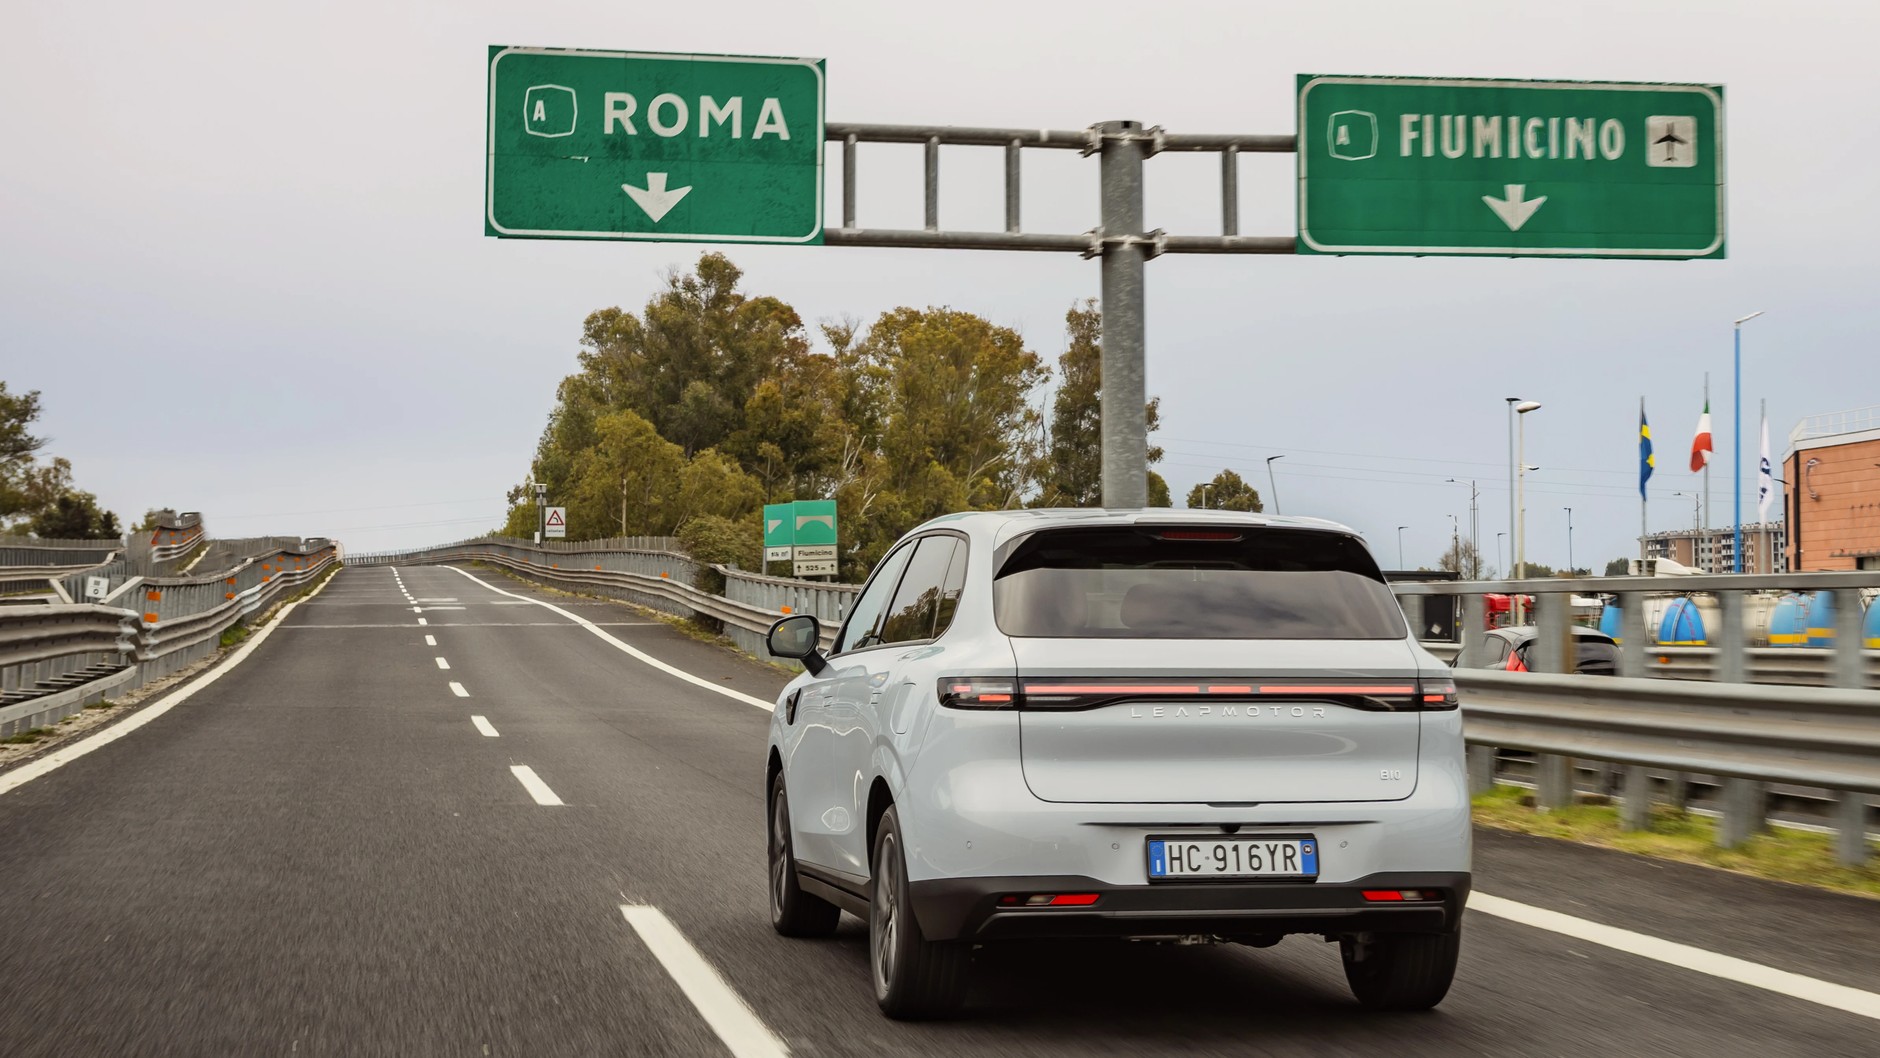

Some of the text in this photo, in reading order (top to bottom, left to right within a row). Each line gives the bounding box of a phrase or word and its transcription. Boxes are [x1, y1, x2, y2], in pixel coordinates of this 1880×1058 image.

[533, 92, 790, 140] A ROMA
[1336, 113, 1625, 160] A FIUMICINO
[1131, 706, 1325, 718] LEAPMOTOR
[1380, 769, 1400, 780] B10
[1168, 844, 1201, 872] HC
[1213, 844, 1297, 872] 916YR
